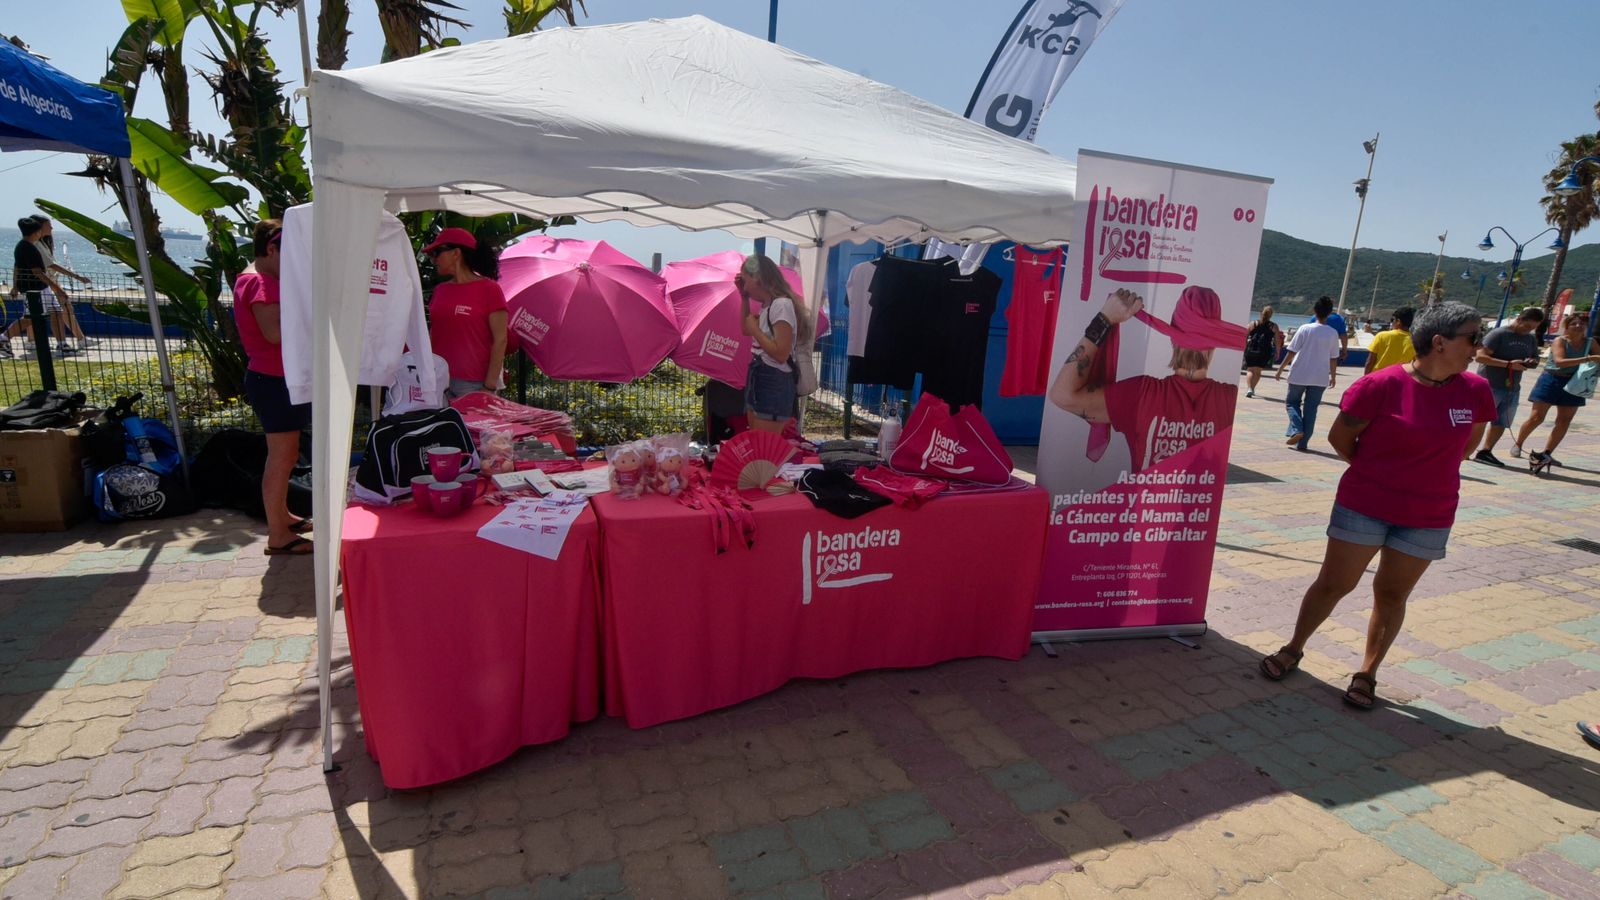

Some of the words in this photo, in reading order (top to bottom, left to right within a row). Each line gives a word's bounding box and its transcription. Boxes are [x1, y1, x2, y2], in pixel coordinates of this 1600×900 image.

[1018, 24, 1080, 55] KCG
[0, 79, 17, 102] de
[19, 85, 73, 120] Algeciras
[1102, 187, 1198, 231] bandera
[1099, 226, 1151, 260] rosa
[515, 318, 533, 333] rosa
[519, 308, 550, 334] bandera
[710, 331, 739, 350] bandera
[1157, 416, 1215, 439] bandera
[1154, 438, 1188, 456] rosa
[1117, 470, 1196, 485] Asociación
[1199, 470, 1215, 484] de
[1053, 489, 1124, 509] pacientes
[1128, 494, 1138, 509] y
[1140, 488, 1213, 505] familiares
[1066, 508, 1116, 525] Cáncer
[1118, 508, 1137, 523] de
[1141, 509, 1185, 523] Mama
[1188, 508, 1210, 523] del
[817, 526, 900, 553] bandera
[1069, 529, 1119, 547] Campo
[1123, 529, 1141, 543] de
[1145, 526, 1207, 542] Gibraltar
[816, 552, 861, 576] rosa
[1142, 572, 1168, 580] Algeciras
